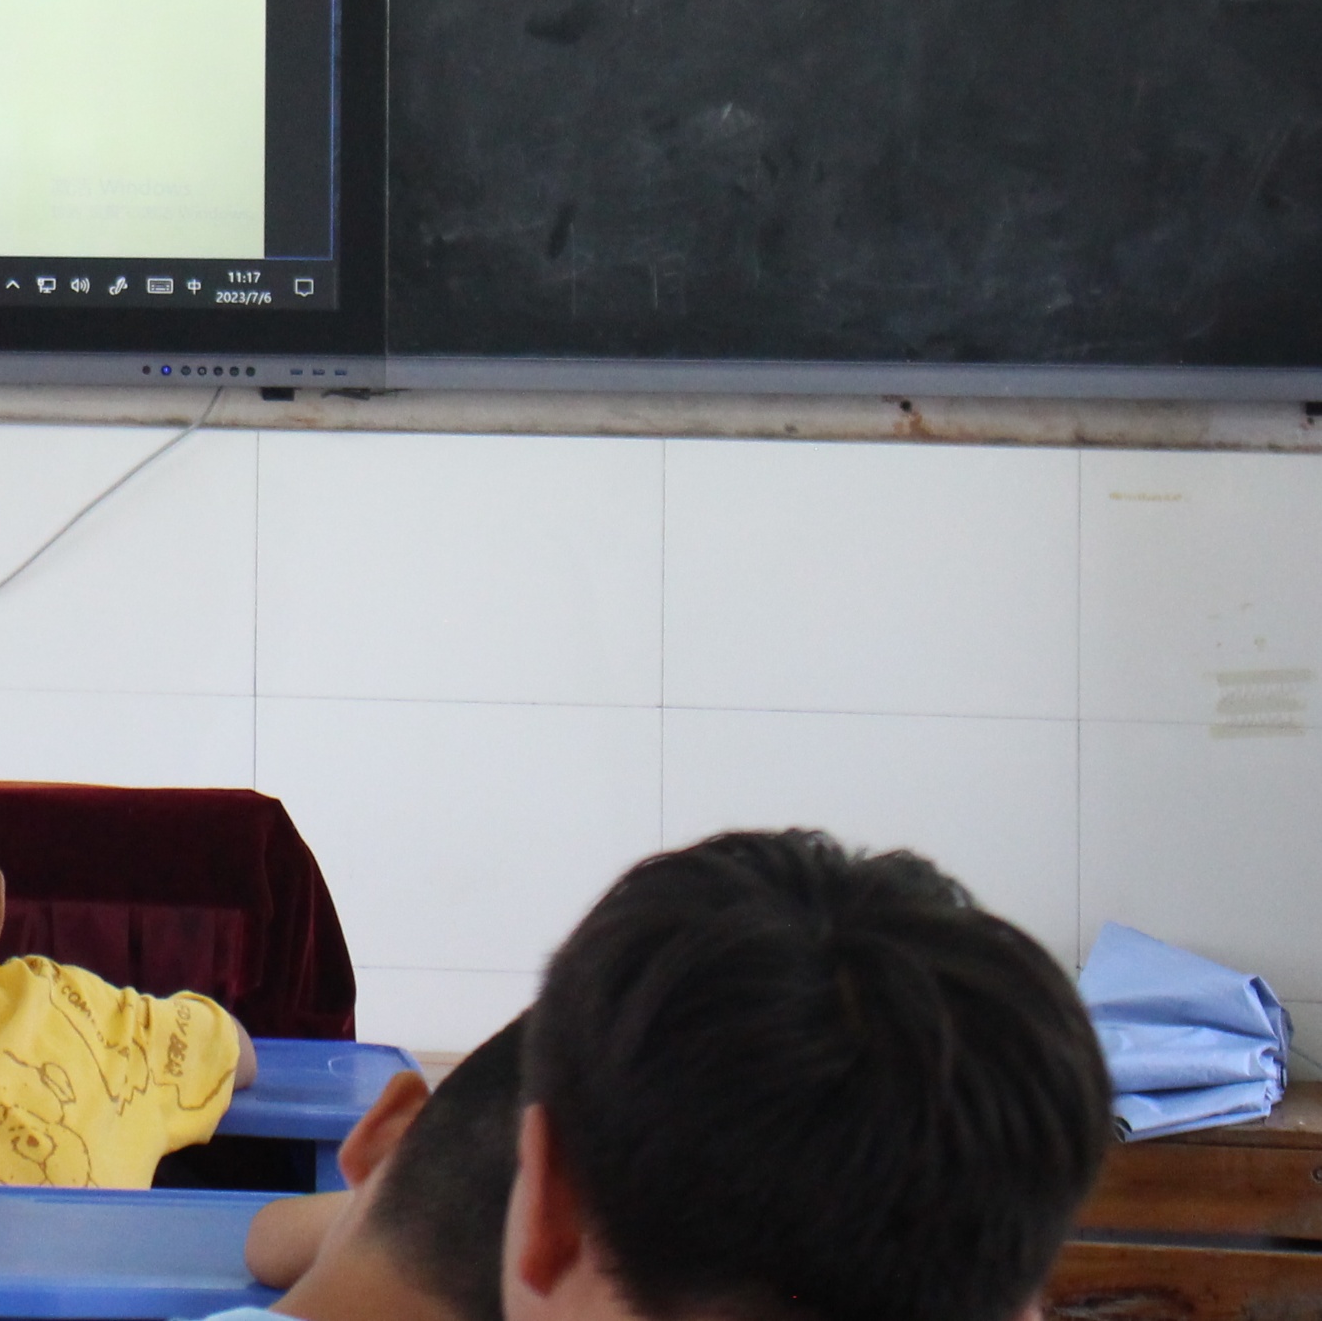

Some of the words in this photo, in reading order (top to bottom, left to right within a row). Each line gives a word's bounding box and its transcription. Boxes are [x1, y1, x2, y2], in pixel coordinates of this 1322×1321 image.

[228, 271, 261, 283] 11:17
[187, 279, 202, 295] 中
[215, 291, 272, 305] 2023/7/6
